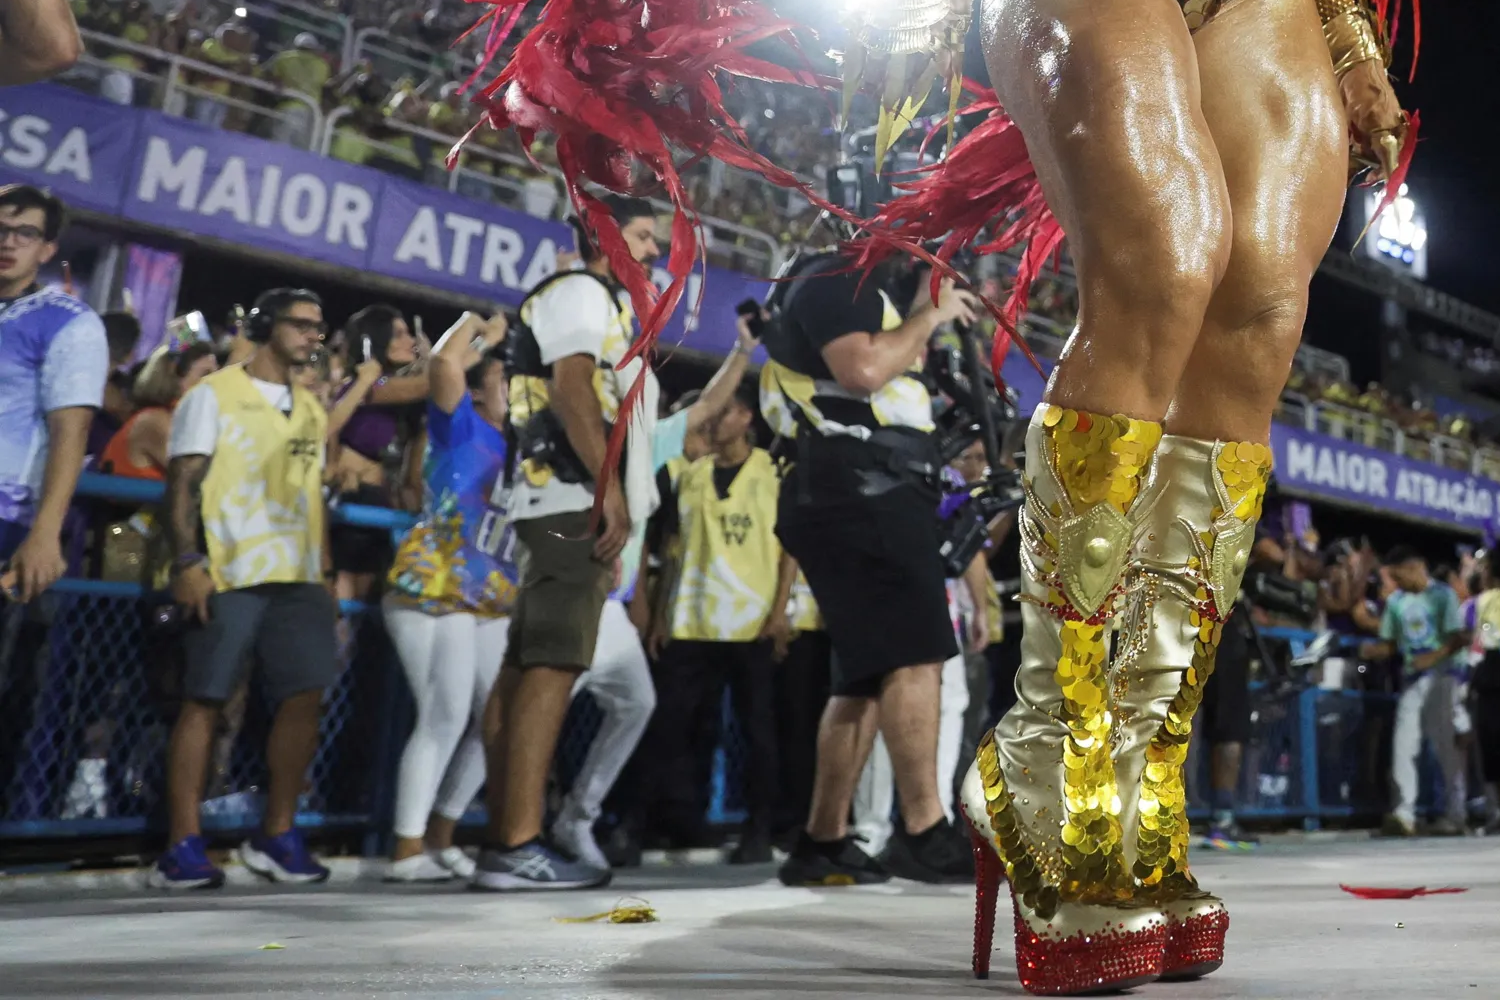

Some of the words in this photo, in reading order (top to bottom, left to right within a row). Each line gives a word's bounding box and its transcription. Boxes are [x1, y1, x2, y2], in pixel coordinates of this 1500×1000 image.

[0, 106, 92, 183] SA
[138, 135, 374, 250] MAIOR
[1287, 438, 1389, 498] MAIOR
